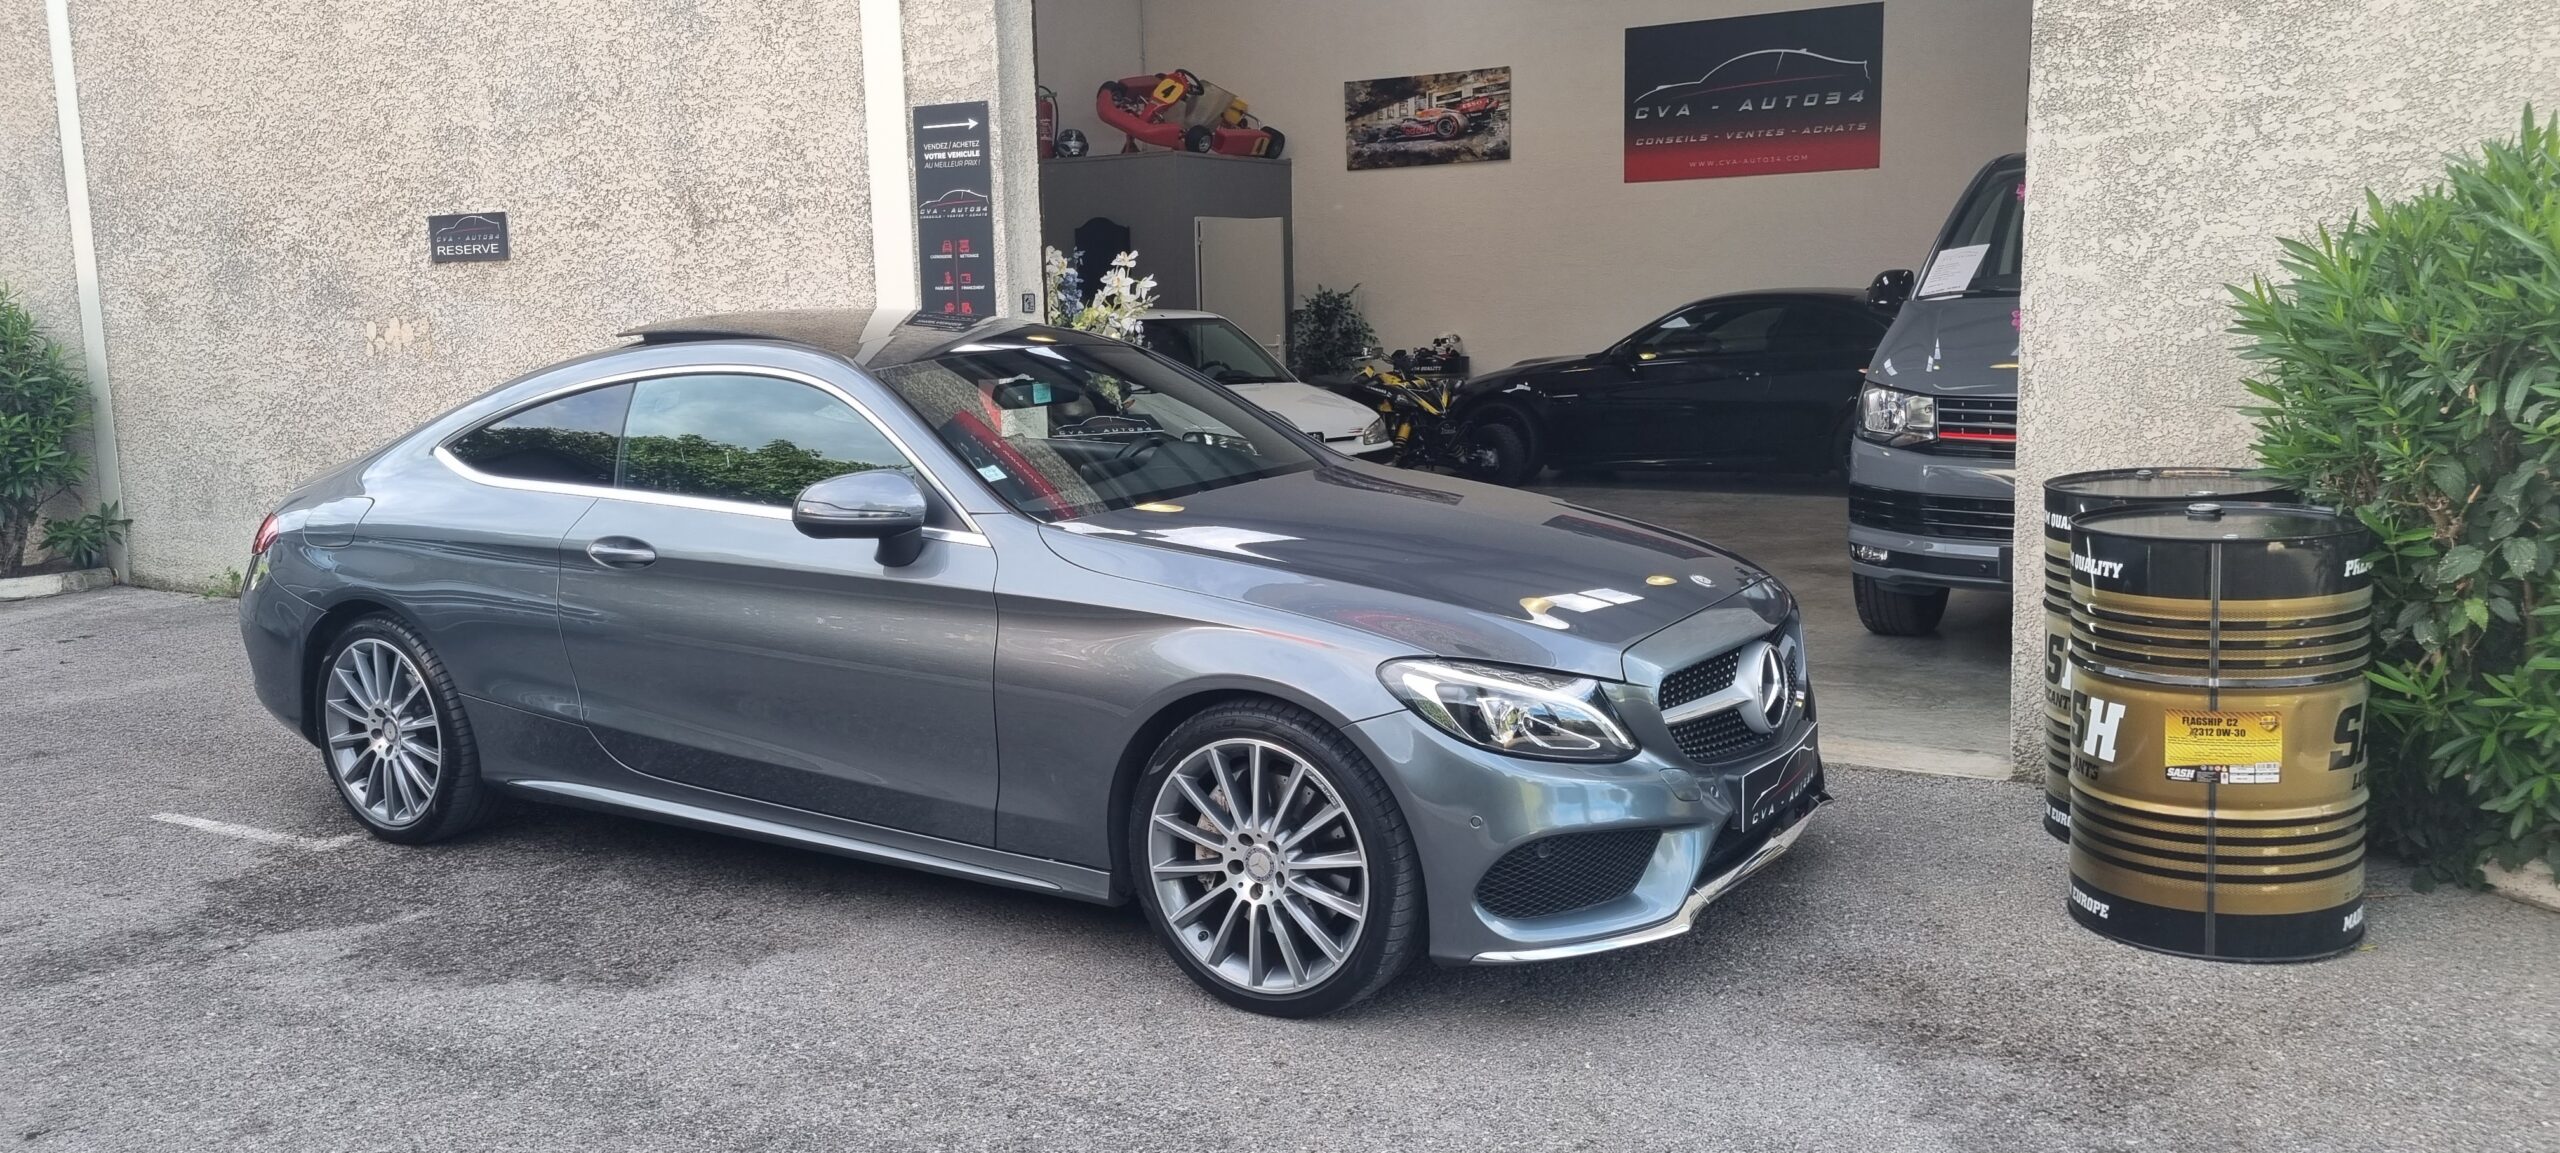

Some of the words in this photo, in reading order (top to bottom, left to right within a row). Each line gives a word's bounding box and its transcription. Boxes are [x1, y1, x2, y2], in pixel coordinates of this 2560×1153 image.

[1634, 104, 1691, 120] CVA
[1738, 89, 1866, 113] AUTO34
[1635, 133, 1709, 146] CONSEILS
[1726, 127, 1786, 140] VENTES
[1801, 122, 1869, 136] ACHATS
[924, 143, 948, 151] VENDEZ
[952, 139, 980, 149] ACHETEZ
[924, 152, 947, 160] VOTRE
[934, 160, 964, 169] MEILLEUR
[964, 159, 978, 167] PRIX
[437, 243, 500, 256] RESERVE
[2074, 553, 2124, 579] QUALITY
[2182, 716, 2223, 726] FLAGSHIP
[2226, 718, 2239, 727] C2
[2216, 728, 2246, 737] 0W-30
[2167, 767, 2195, 778] SASH
[2072, 885, 2110, 920] EUROPE
